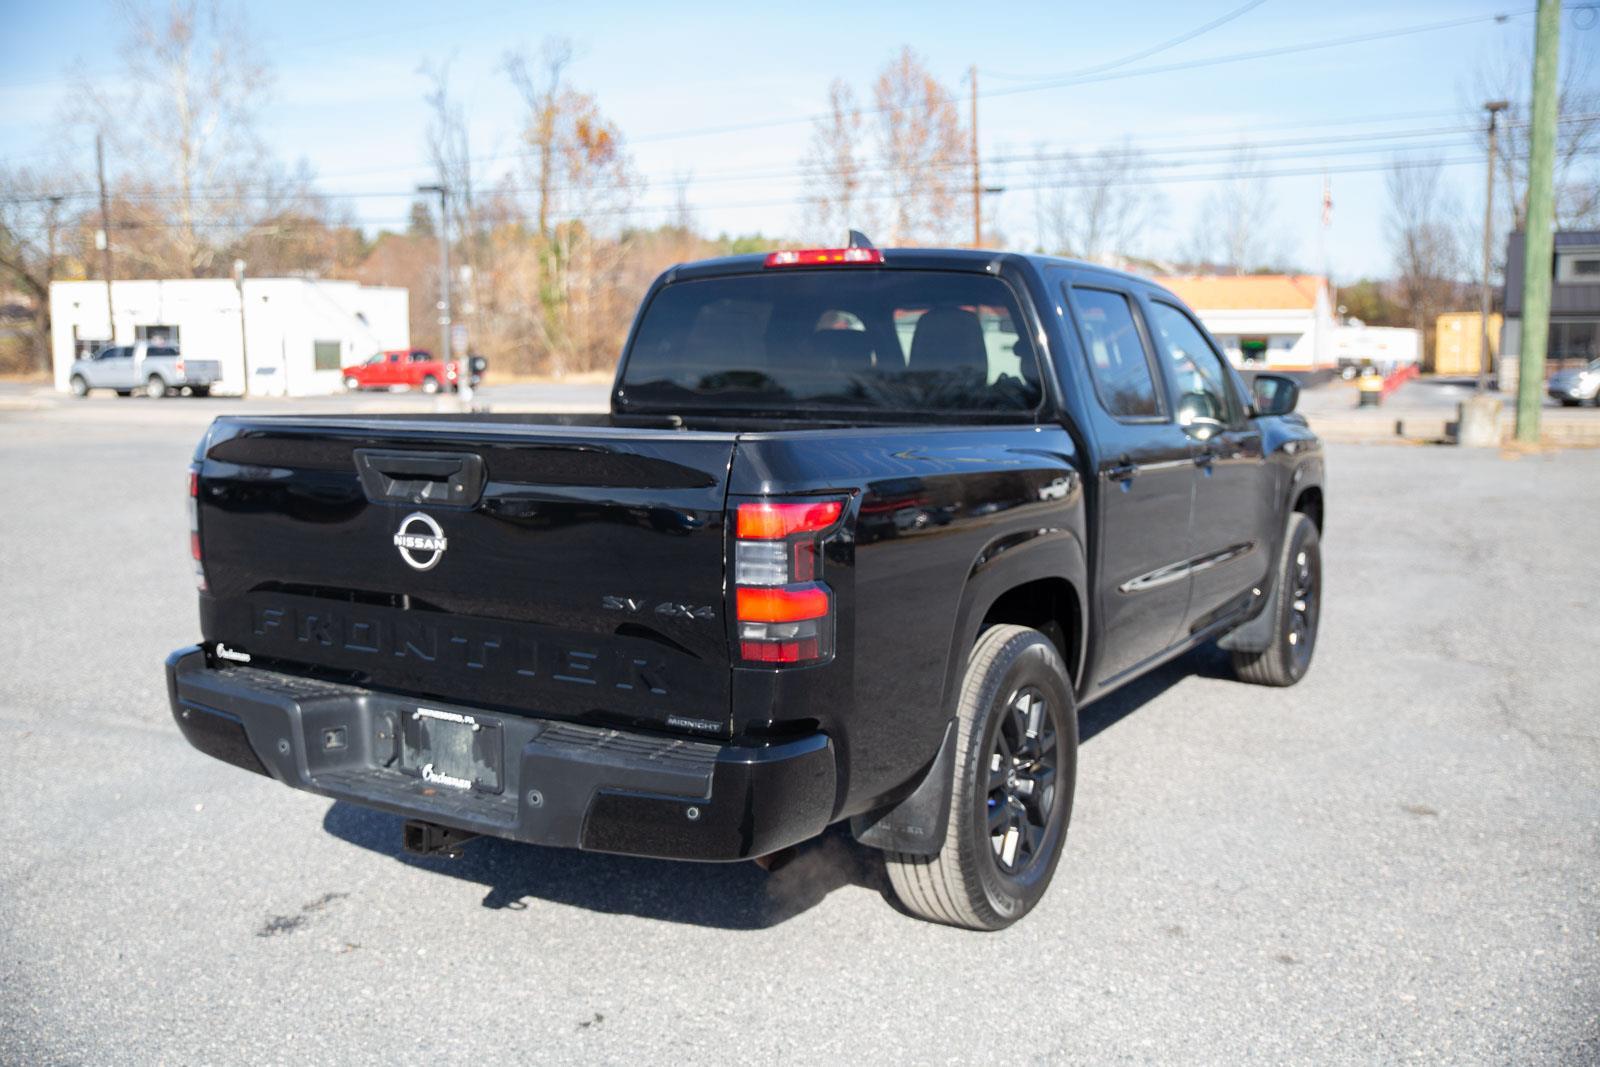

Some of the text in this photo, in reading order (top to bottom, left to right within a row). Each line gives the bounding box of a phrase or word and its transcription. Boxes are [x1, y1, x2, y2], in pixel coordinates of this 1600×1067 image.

[393, 533, 448, 551] NISSAN
[602, 595, 646, 612] SV
[251, 607, 669, 695] FRONTIER
[667, 716, 722, 732] MIDNIGHT
